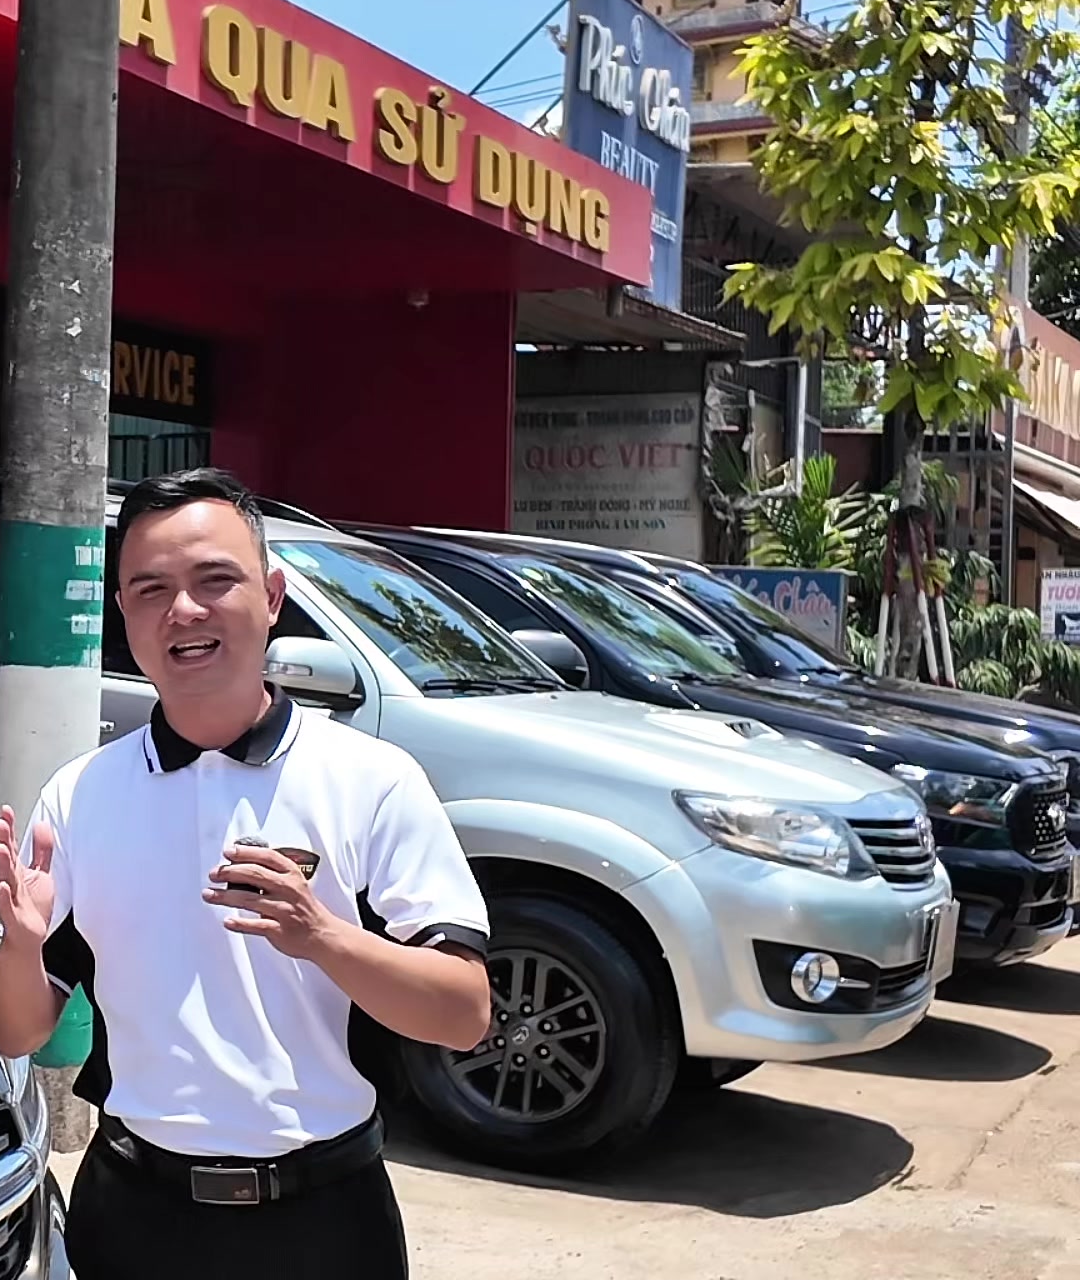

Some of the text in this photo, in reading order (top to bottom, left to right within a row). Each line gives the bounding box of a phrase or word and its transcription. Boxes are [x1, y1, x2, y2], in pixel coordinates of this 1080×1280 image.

[201, 3, 357, 144] QUA
[373, 84, 467, 186] SỬ
[474, 133, 611, 253] DỤNG
[600, 130, 660, 198] BEAUTY
